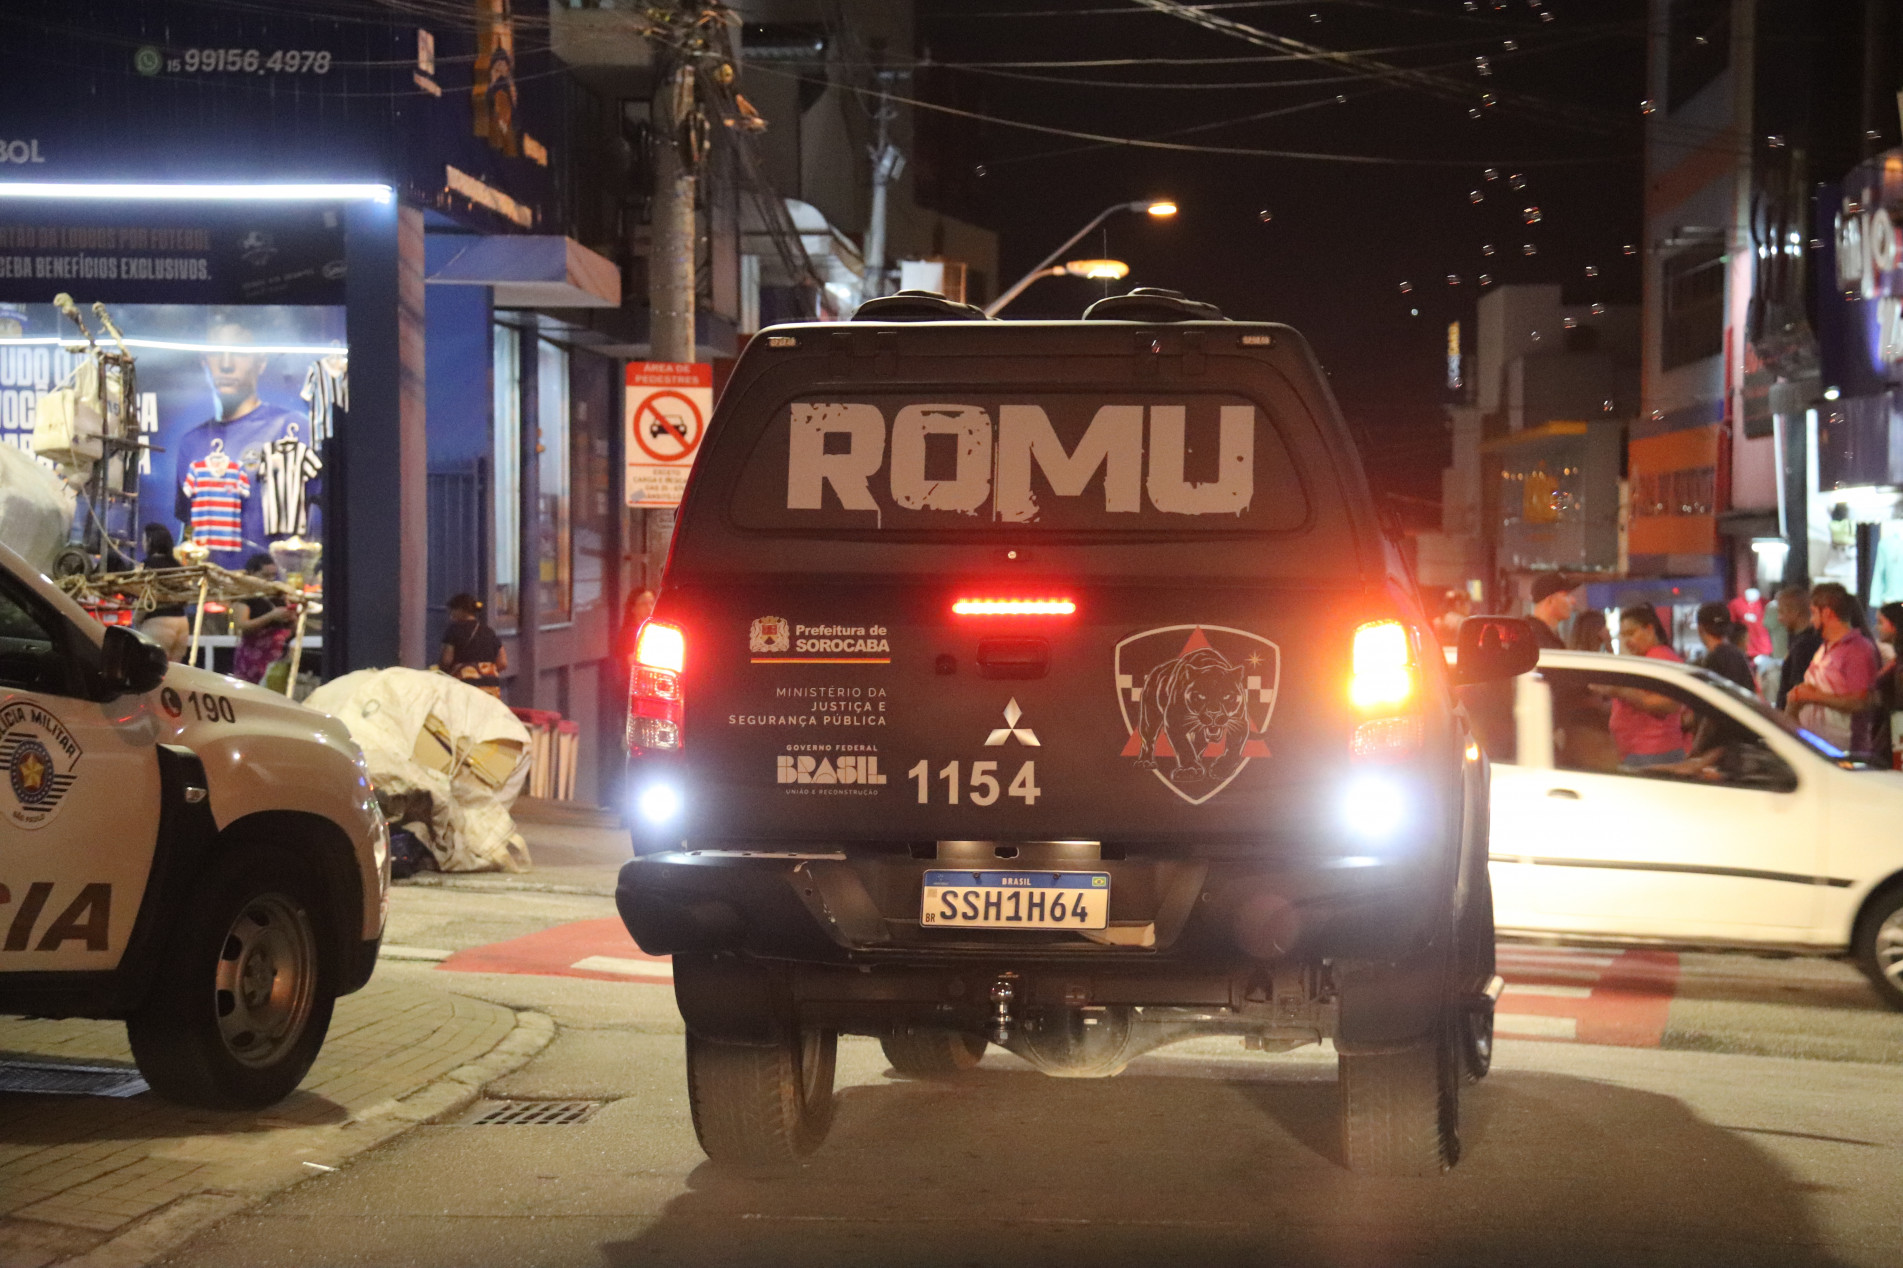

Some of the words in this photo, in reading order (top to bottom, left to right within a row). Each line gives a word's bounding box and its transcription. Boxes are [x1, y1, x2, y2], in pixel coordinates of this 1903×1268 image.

[184, 49, 332, 76] 99156.4978
[35, 252, 118, 280] BENEFÍCIOS
[120, 257, 212, 281] EXCLUSIVOS.
[634, 374, 700, 385] PEDESTRES
[786, 402, 1256, 530] ROMU
[795, 624, 866, 636] Prefeitura
[869, 624, 887, 636] de
[796, 638, 890, 653] SOROCABA
[776, 685, 861, 698] MINISTÉRIO
[868, 687, 887, 698] DA
[188, 691, 236, 724] 190
[811, 701, 872, 714] JUSTIÇA
[878, 702, 886, 712] E
[728, 714, 818, 728] SEGURANÇA
[823, 713, 887, 726] PÚBLICA
[30, 708, 77, 758] MILITAR
[786, 744, 832, 752] GOVERNO
[835, 744, 878, 752] FEDERAL
[777, 755, 887, 784] BRASIL
[908, 759, 1042, 806] 1154
[785, 788, 809, 796] UNIÃO
[1001, 877, 1032, 886] BRASIL
[939, 890, 1088, 923] SSH1H64
[0, 882, 112, 951] IA
[925, 913, 936, 923] BR
